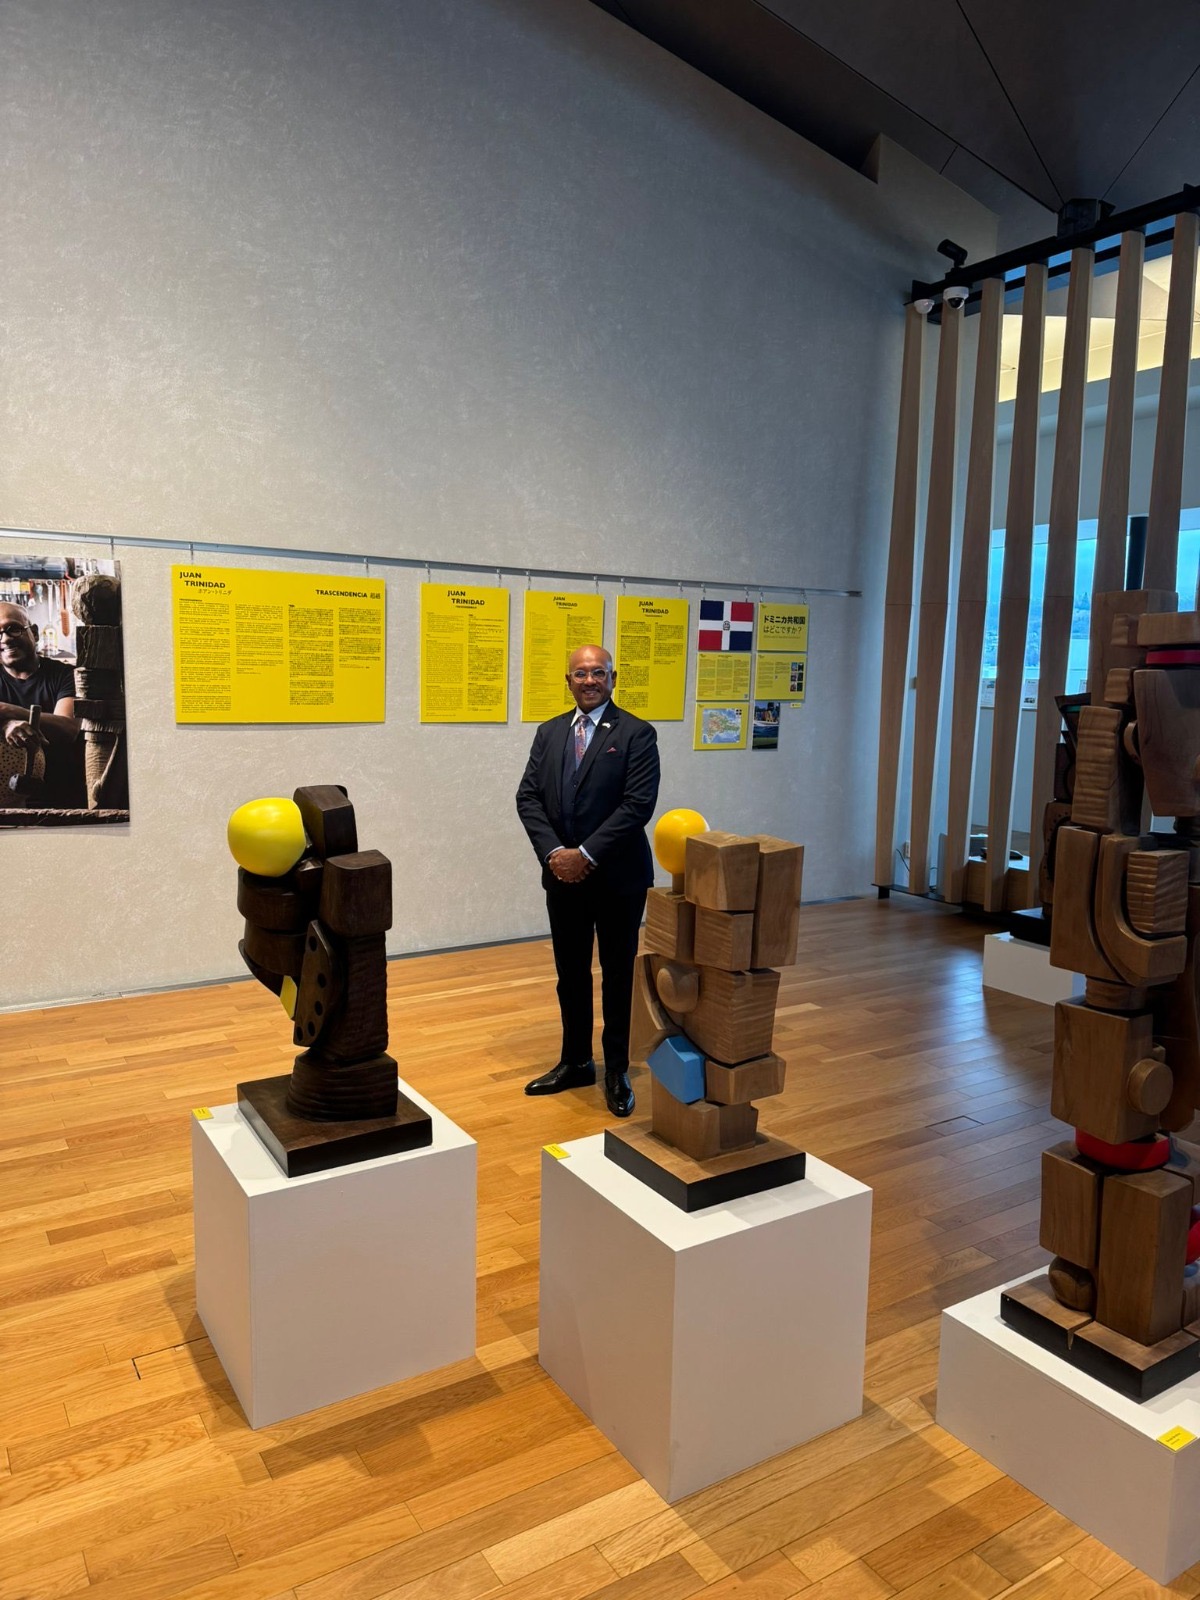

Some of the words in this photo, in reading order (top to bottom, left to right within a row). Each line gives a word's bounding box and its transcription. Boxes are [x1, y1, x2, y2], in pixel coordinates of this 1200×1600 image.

[179, 571, 202, 579] JUAN
[184, 580, 225, 588] TRINIDAD
[315, 589, 368, 598] TRASCENDENCIA
[451, 598, 485, 606] TRINIDAD
[641, 607, 670, 615] TRINIDAD
[764, 614, 806, 625] ドミニカ共和国
